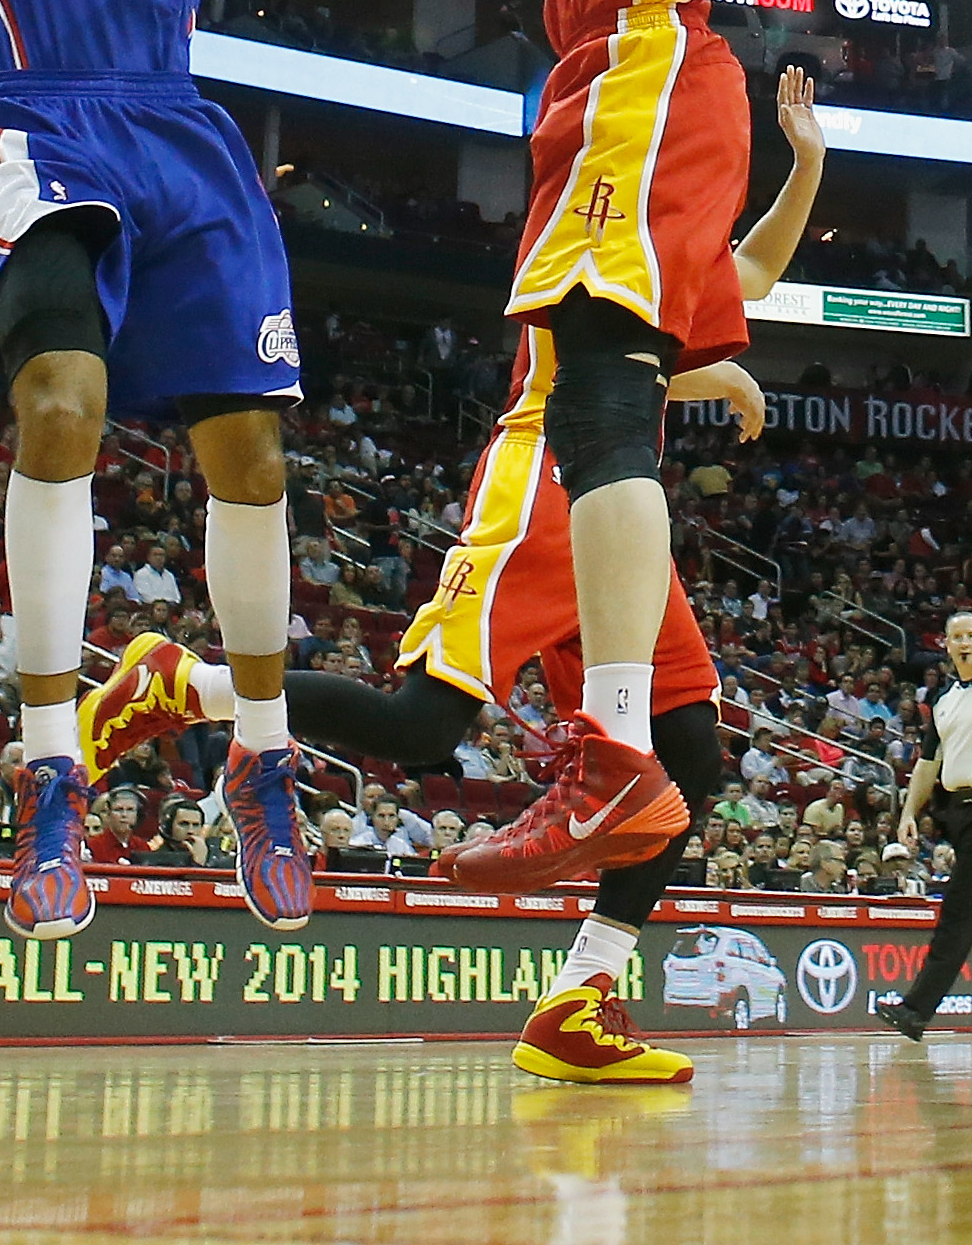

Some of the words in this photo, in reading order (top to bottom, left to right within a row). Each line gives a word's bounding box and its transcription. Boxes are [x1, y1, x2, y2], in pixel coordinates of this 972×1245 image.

[682, 392, 851, 435] HOSTON
[243, 943, 361, 1003] 2014
[377, 944, 645, 1003] HIGHLANR
